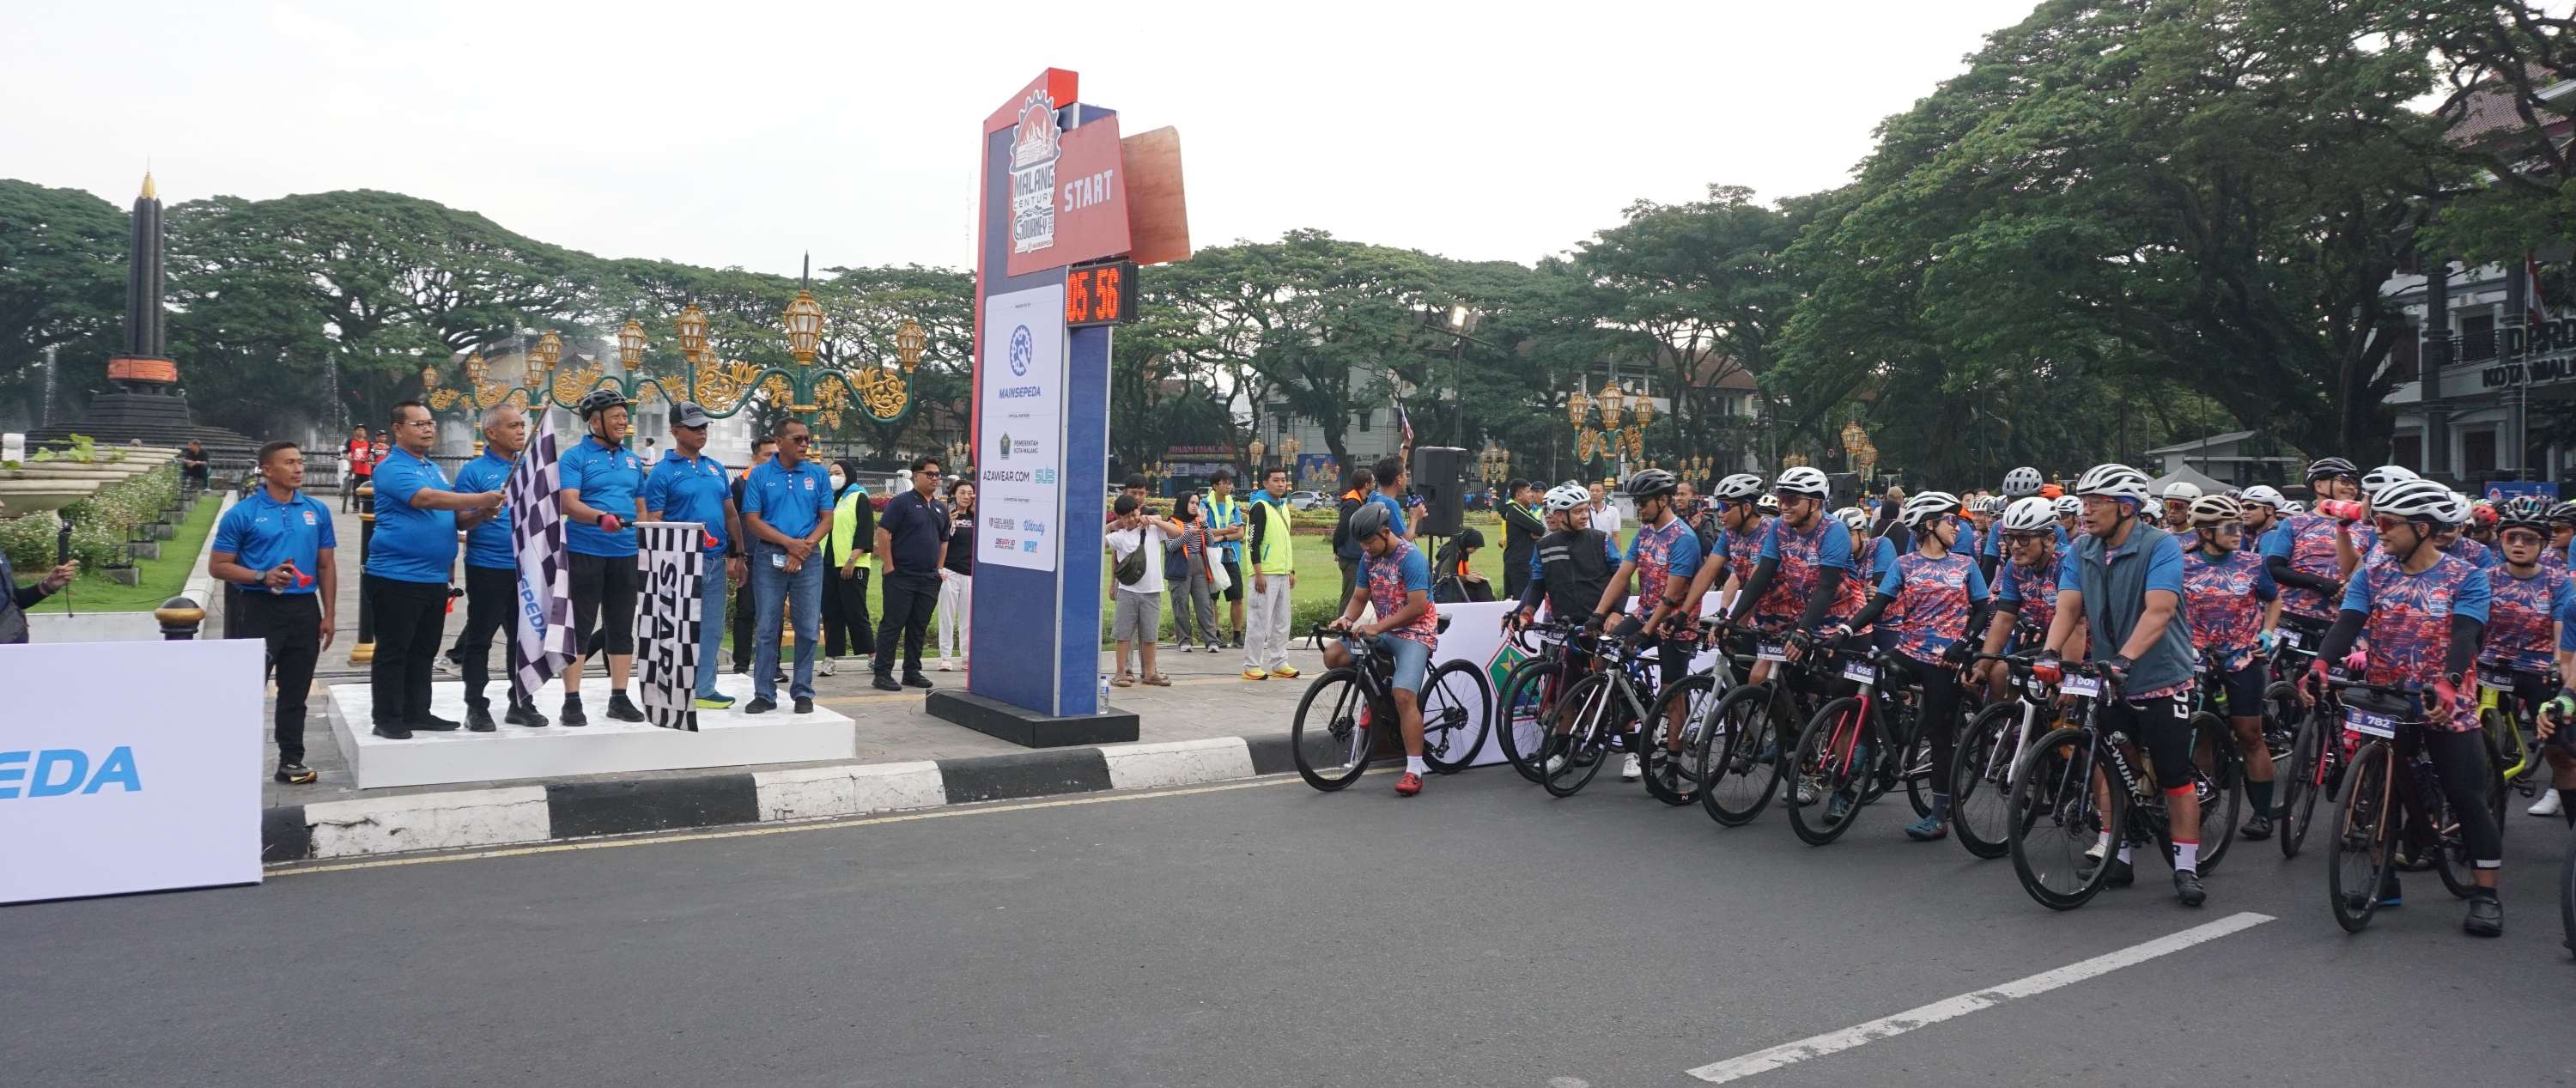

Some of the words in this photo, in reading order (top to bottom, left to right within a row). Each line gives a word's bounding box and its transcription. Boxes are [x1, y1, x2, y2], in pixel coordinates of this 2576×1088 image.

[1014, 164, 1054, 198] MALANG
[1064, 169, 1113, 212] START
[1013, 191, 1054, 210] CENTURY
[1066, 271, 1089, 322] 05
[1096, 268, 1119, 319] 56
[2482, 362, 2532, 387] KOTA
[999, 386, 1042, 399] MAINSEPEDA
[1013, 439, 1039, 447] PEMERINTAH
[982, 469, 1030, 482] AZAWEAR.COM
[657, 557, 678, 706] START
[1856, 666, 1873, 677] 055
[2076, 678, 2095, 687] 001
[2367, 715, 2391, 728] 782
